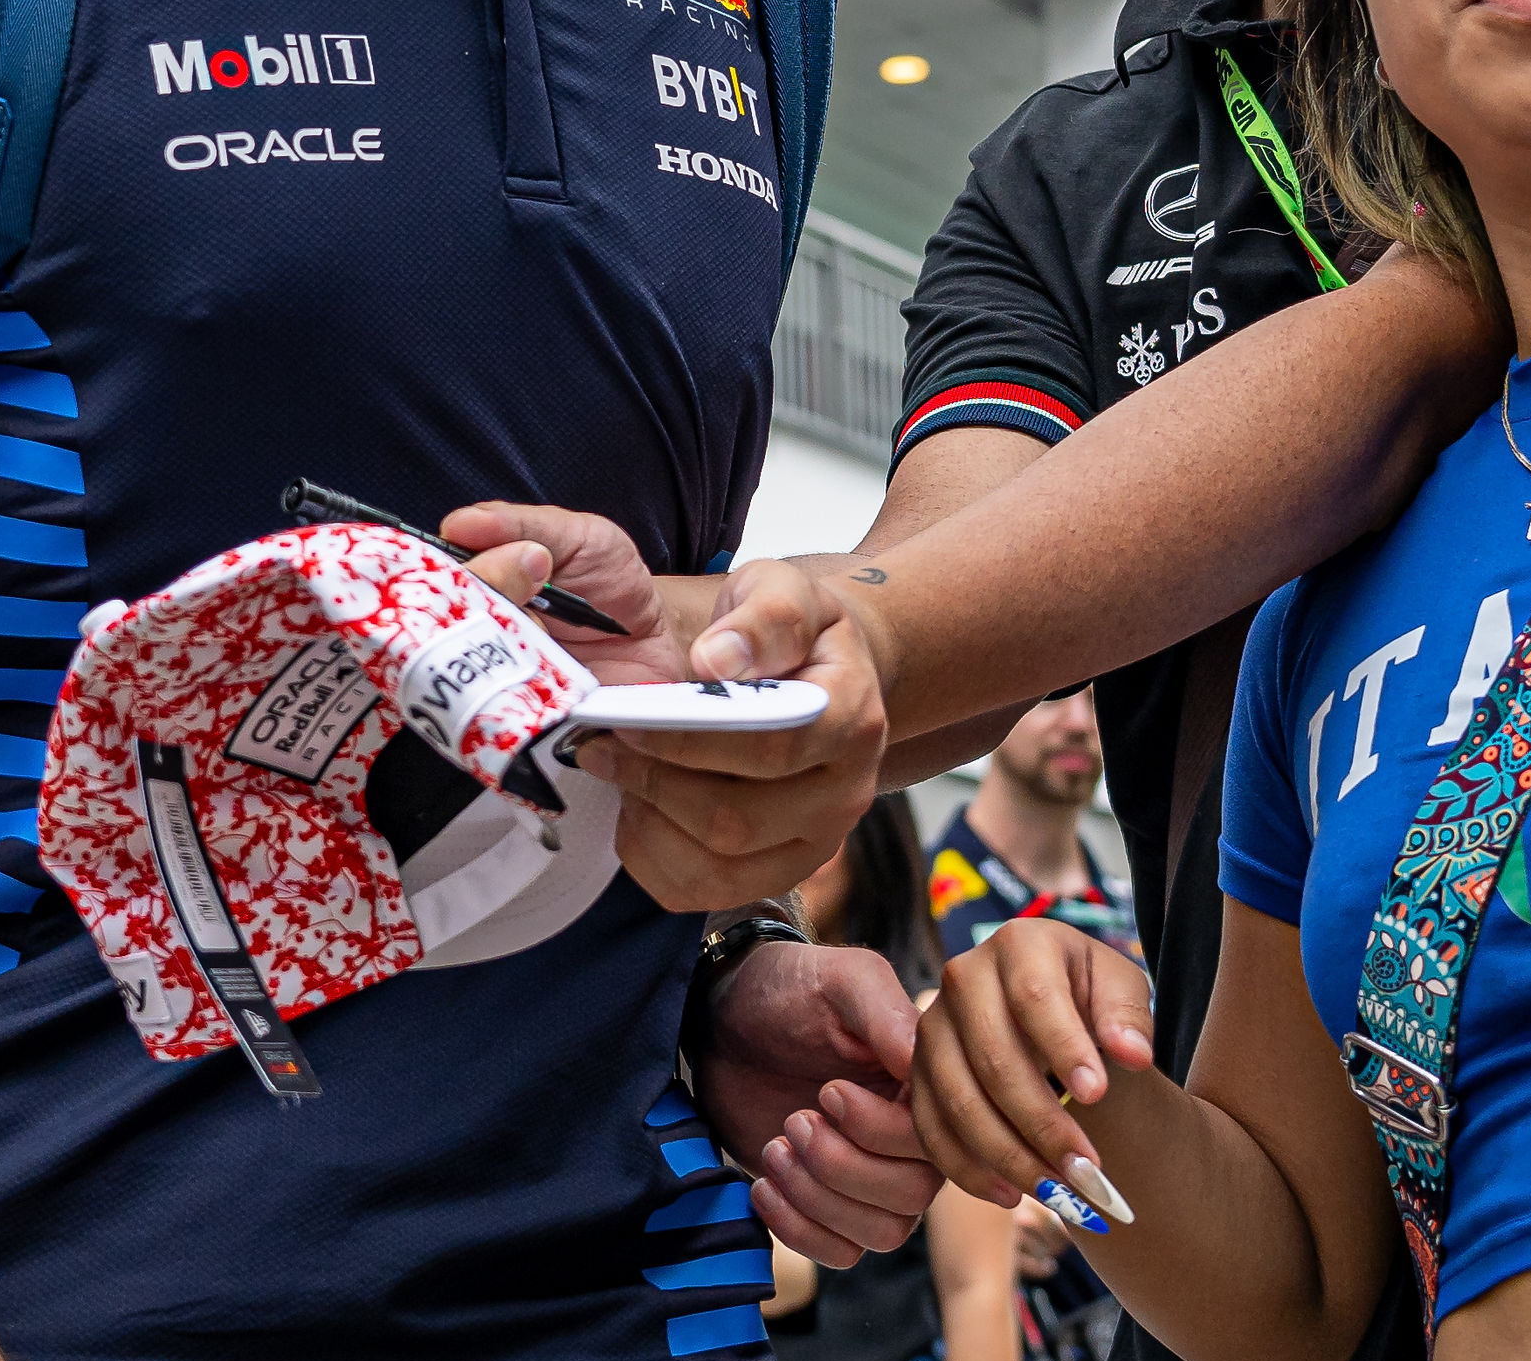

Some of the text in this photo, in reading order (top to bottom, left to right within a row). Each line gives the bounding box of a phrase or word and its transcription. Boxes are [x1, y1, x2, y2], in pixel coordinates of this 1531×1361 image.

[148, 34, 320, 95] Mobil
[652, 54, 761, 136] BYBIT
[164, 128, 385, 170] ORACLE
[654, 143, 779, 212] HONDA
